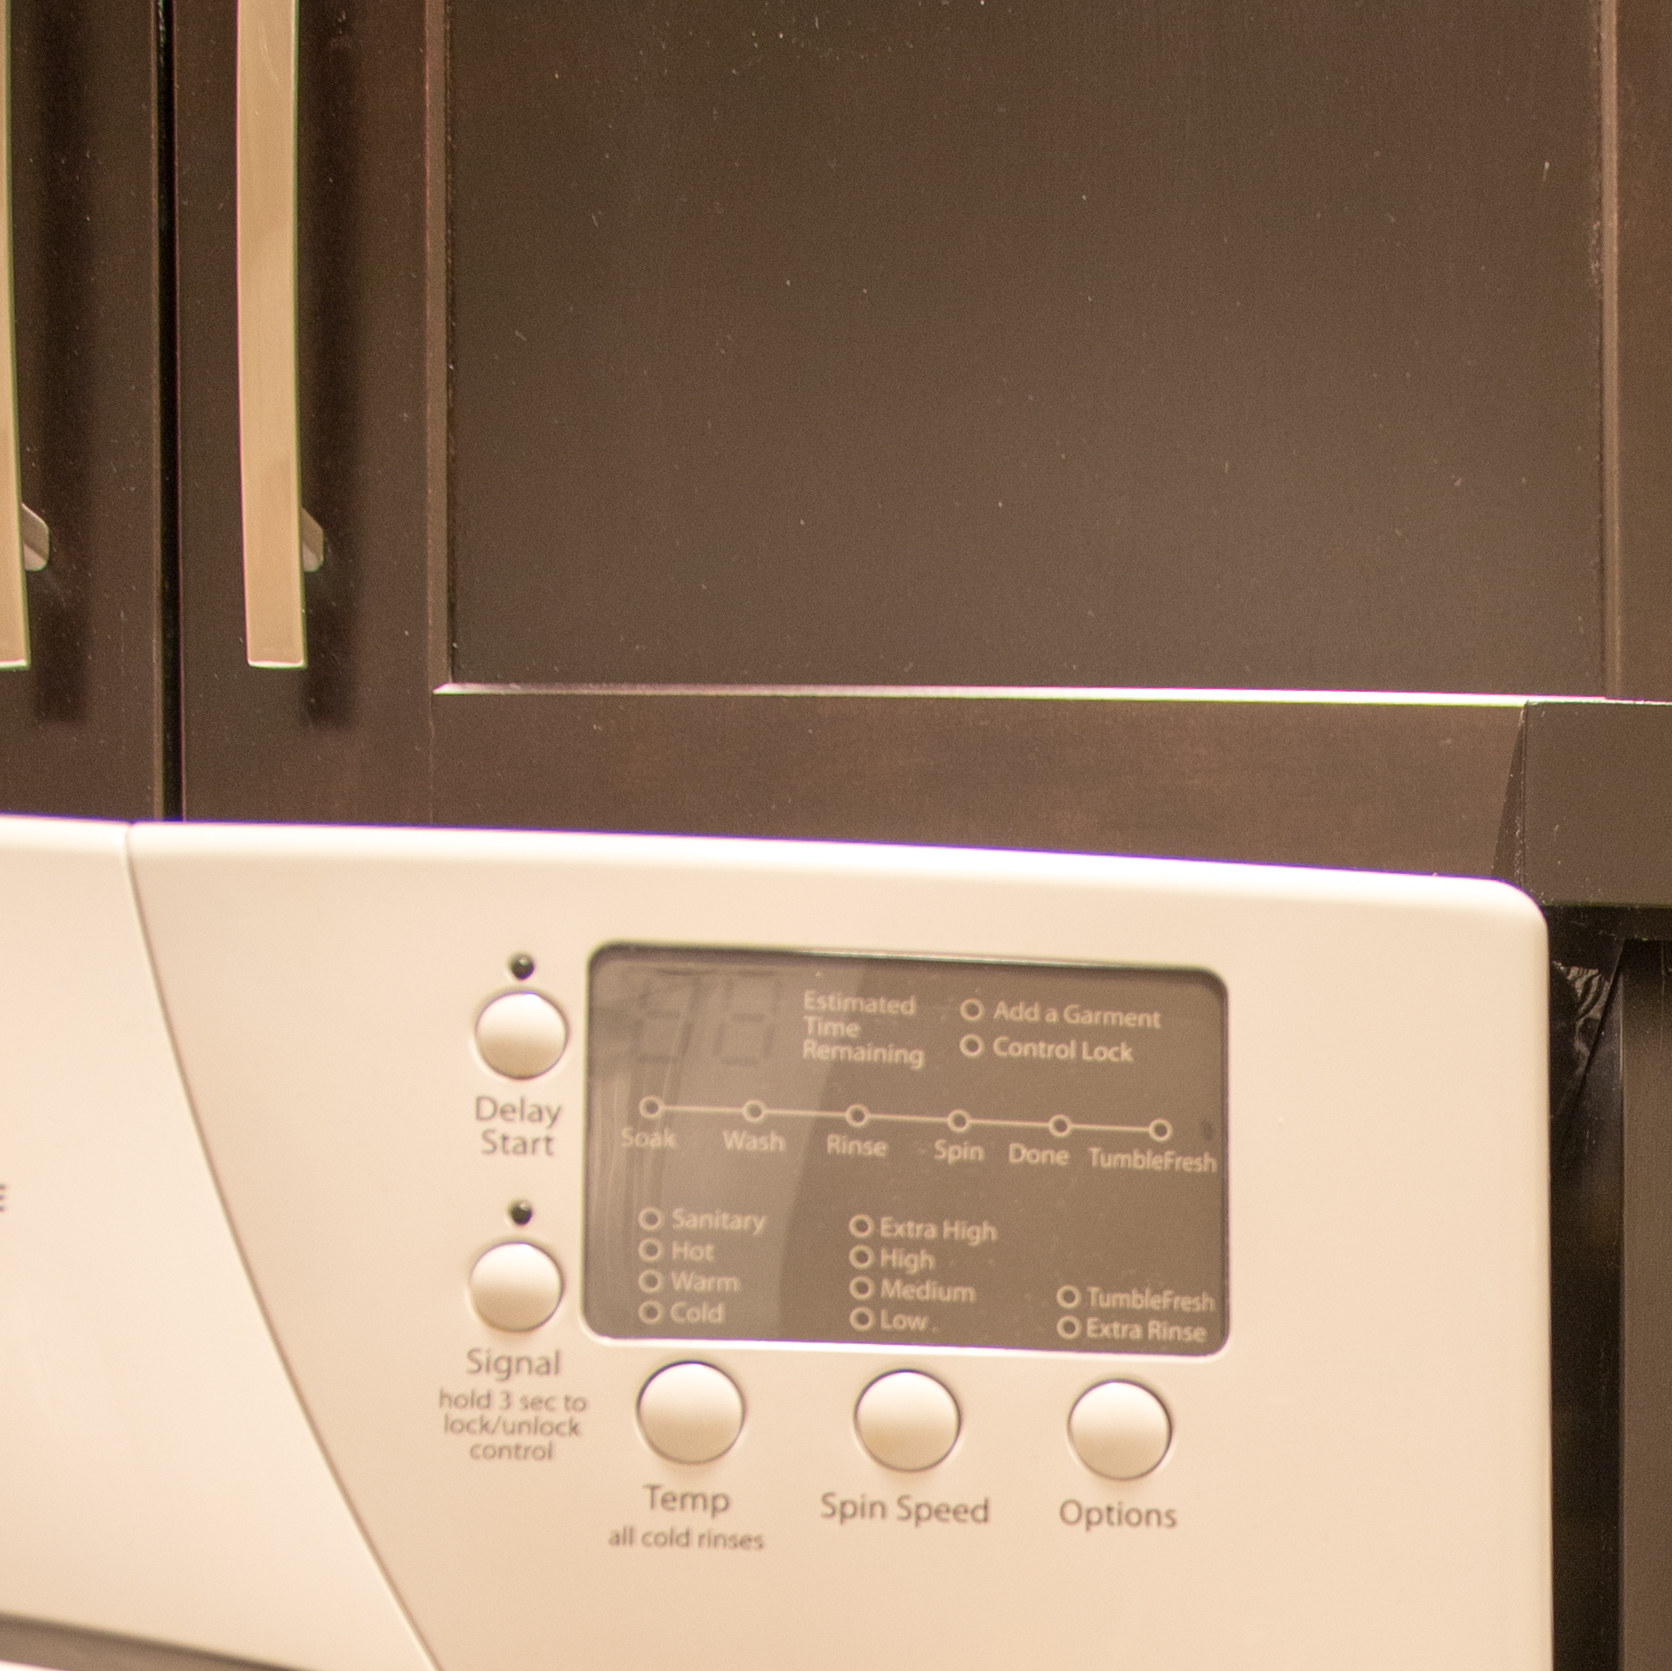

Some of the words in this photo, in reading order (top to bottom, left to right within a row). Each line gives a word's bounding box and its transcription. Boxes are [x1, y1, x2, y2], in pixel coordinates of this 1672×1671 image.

[804, 990, 917, 1017] Estimated
[993, 1001, 1039, 1022] Add
[1045, 1008, 1059, 1023] a
[1063, 1004, 1161, 1029] Garment
[804, 1016, 861, 1039] Time
[802, 1039, 926, 1070] Remaining
[993, 1036, 1077, 1059] Control
[1082, 1041, 1134, 1063] Lock
[475, 1096, 562, 1129] Delay
[481, 1129, 555, 1157] Start
[621, 1127, 677, 1149] Soak
[723, 1130, 787, 1152] Wash
[827, 1133, 889, 1157] Rinse
[934, 1138, 985, 1164] Spin
[1009, 1143, 1070, 1166] Done
[1088, 1146, 1218, 1173] TumbleFresh
[672, 1207, 767, 1236] Sanitary
[880, 1216, 938, 1240] Extra
[943, 1220, 998, 1247] High
[672, 1240, 715, 1262] Hot
[880, 1248, 936, 1275] High
[671, 1271, 740, 1293] Warm
[880, 1278, 977, 1303] Medium
[671, 1301, 725, 1324] Cold
[1087, 1286, 1217, 1313] TumbleFresh
[880, 1309, 930, 1331] Low
[1087, 1316, 1143, 1341] Extra
[1148, 1319, 1209, 1343] Rinse
[466, 1349, 561, 1382] Signal
[439, 1388, 492, 1410] hold
[500, 1391, 512, 1411] 3
[519, 1396, 557, 1412] sec
[564, 1392, 587, 1413] to
[444, 1415, 582, 1437] lock/unlock
[469, 1441, 554, 1461] control
[643, 1484, 732, 1519] Temp
[820, 1492, 887, 1526] Spin
[896, 1496, 990, 1529] Speed
[1059, 1499, 1178, 1531] Options
[609, 1526, 634, 1548] all
[641, 1527, 690, 1550] cold
[698, 1527, 764, 1551] rinses
